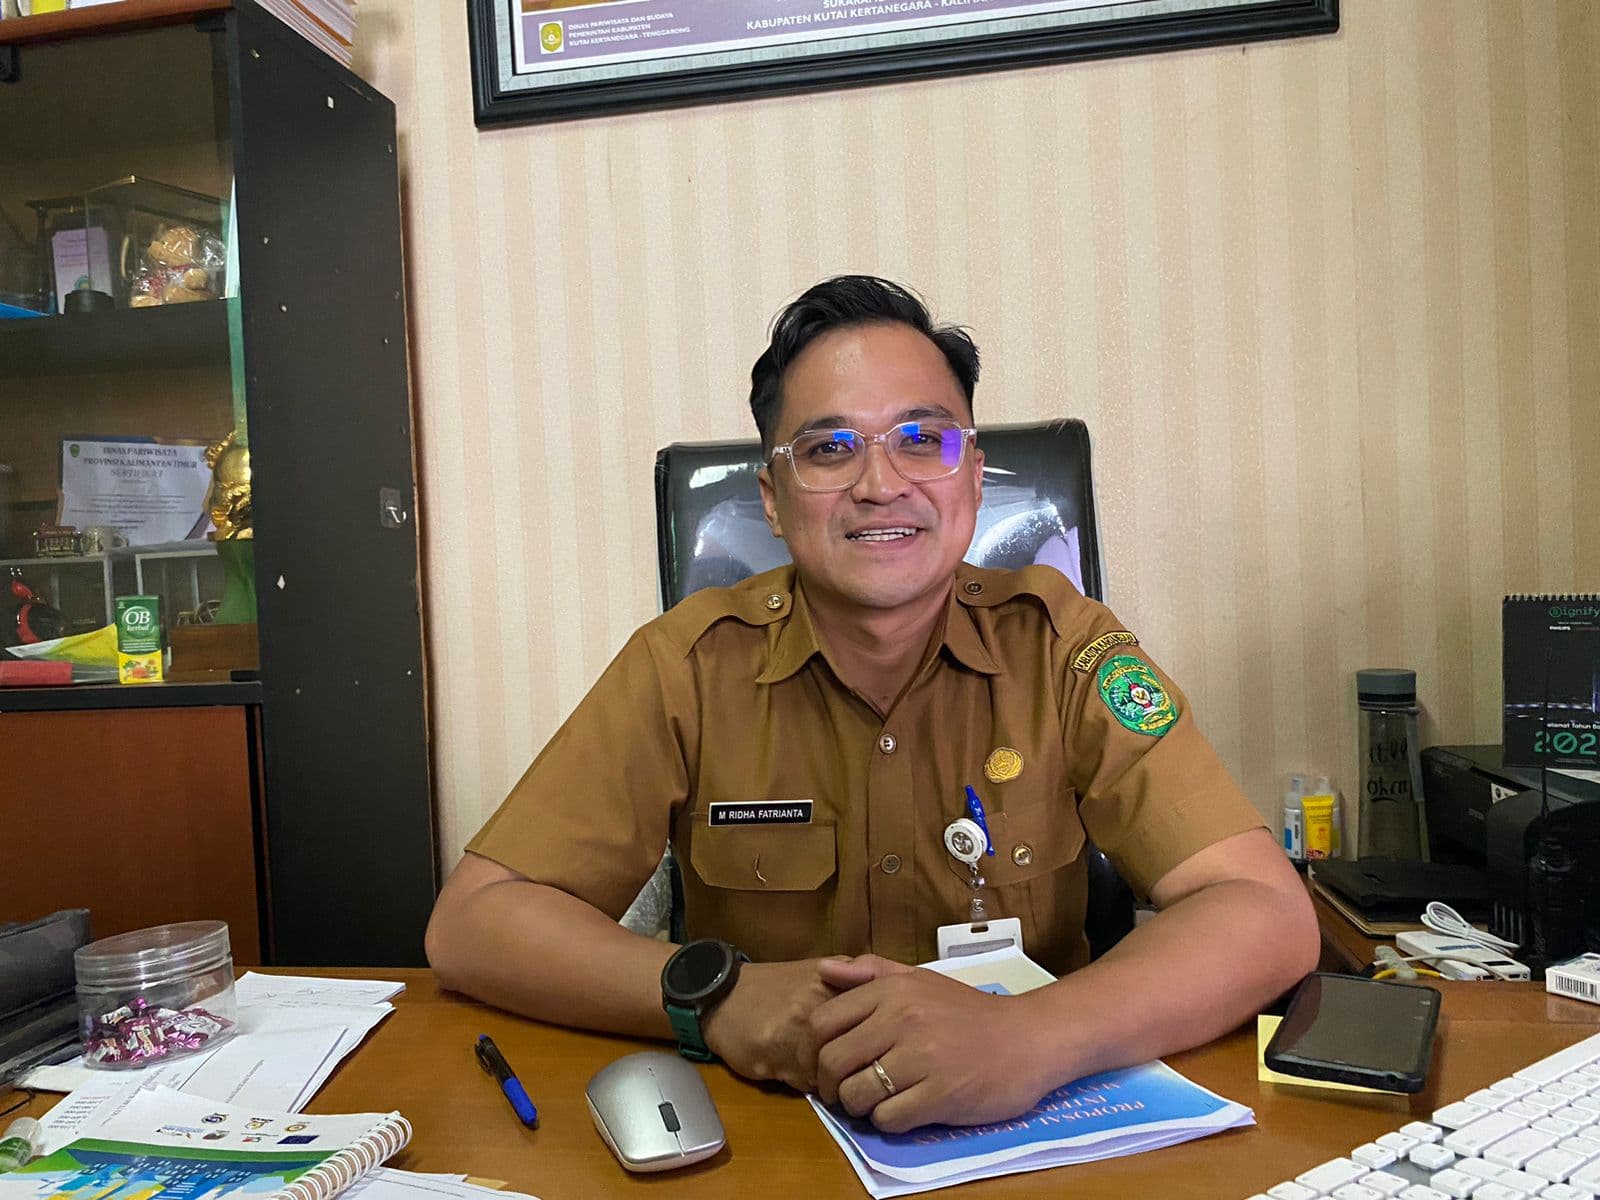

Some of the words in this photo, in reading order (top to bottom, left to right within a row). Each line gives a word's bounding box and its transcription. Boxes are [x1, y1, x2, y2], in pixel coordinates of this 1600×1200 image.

[568, 22, 589, 30] DINAS
[590, 17, 629, 27] PARIWISATA
[646, 12, 674, 21] BUDAYA
[746, 13, 812, 30] KABUPATEN
[813, 9, 848, 22] KUTAI
[850, 1, 932, 18] KERTANEGARA
[568, 28, 611, 39] PEMERINTAH
[611, 23, 651, 33] KABUPATEN
[569, 39, 590, 47] KUTAI
[643, 26, 691, 38] TENGGARONG
[103, 447, 127, 455] DINAS
[119, 458, 172, 468] KALIMANTAN
[173, 460, 198, 469] TIMUR
[125, 611, 151, 625] OB
[718, 811, 726, 820] M
[728, 810, 756, 820] RIDHA
[758, 808, 804, 819] FATRIANTA
[1031, 1094, 1108, 1114] INTERN
[1039, 1100, 1145, 1126] PROPOSAL
